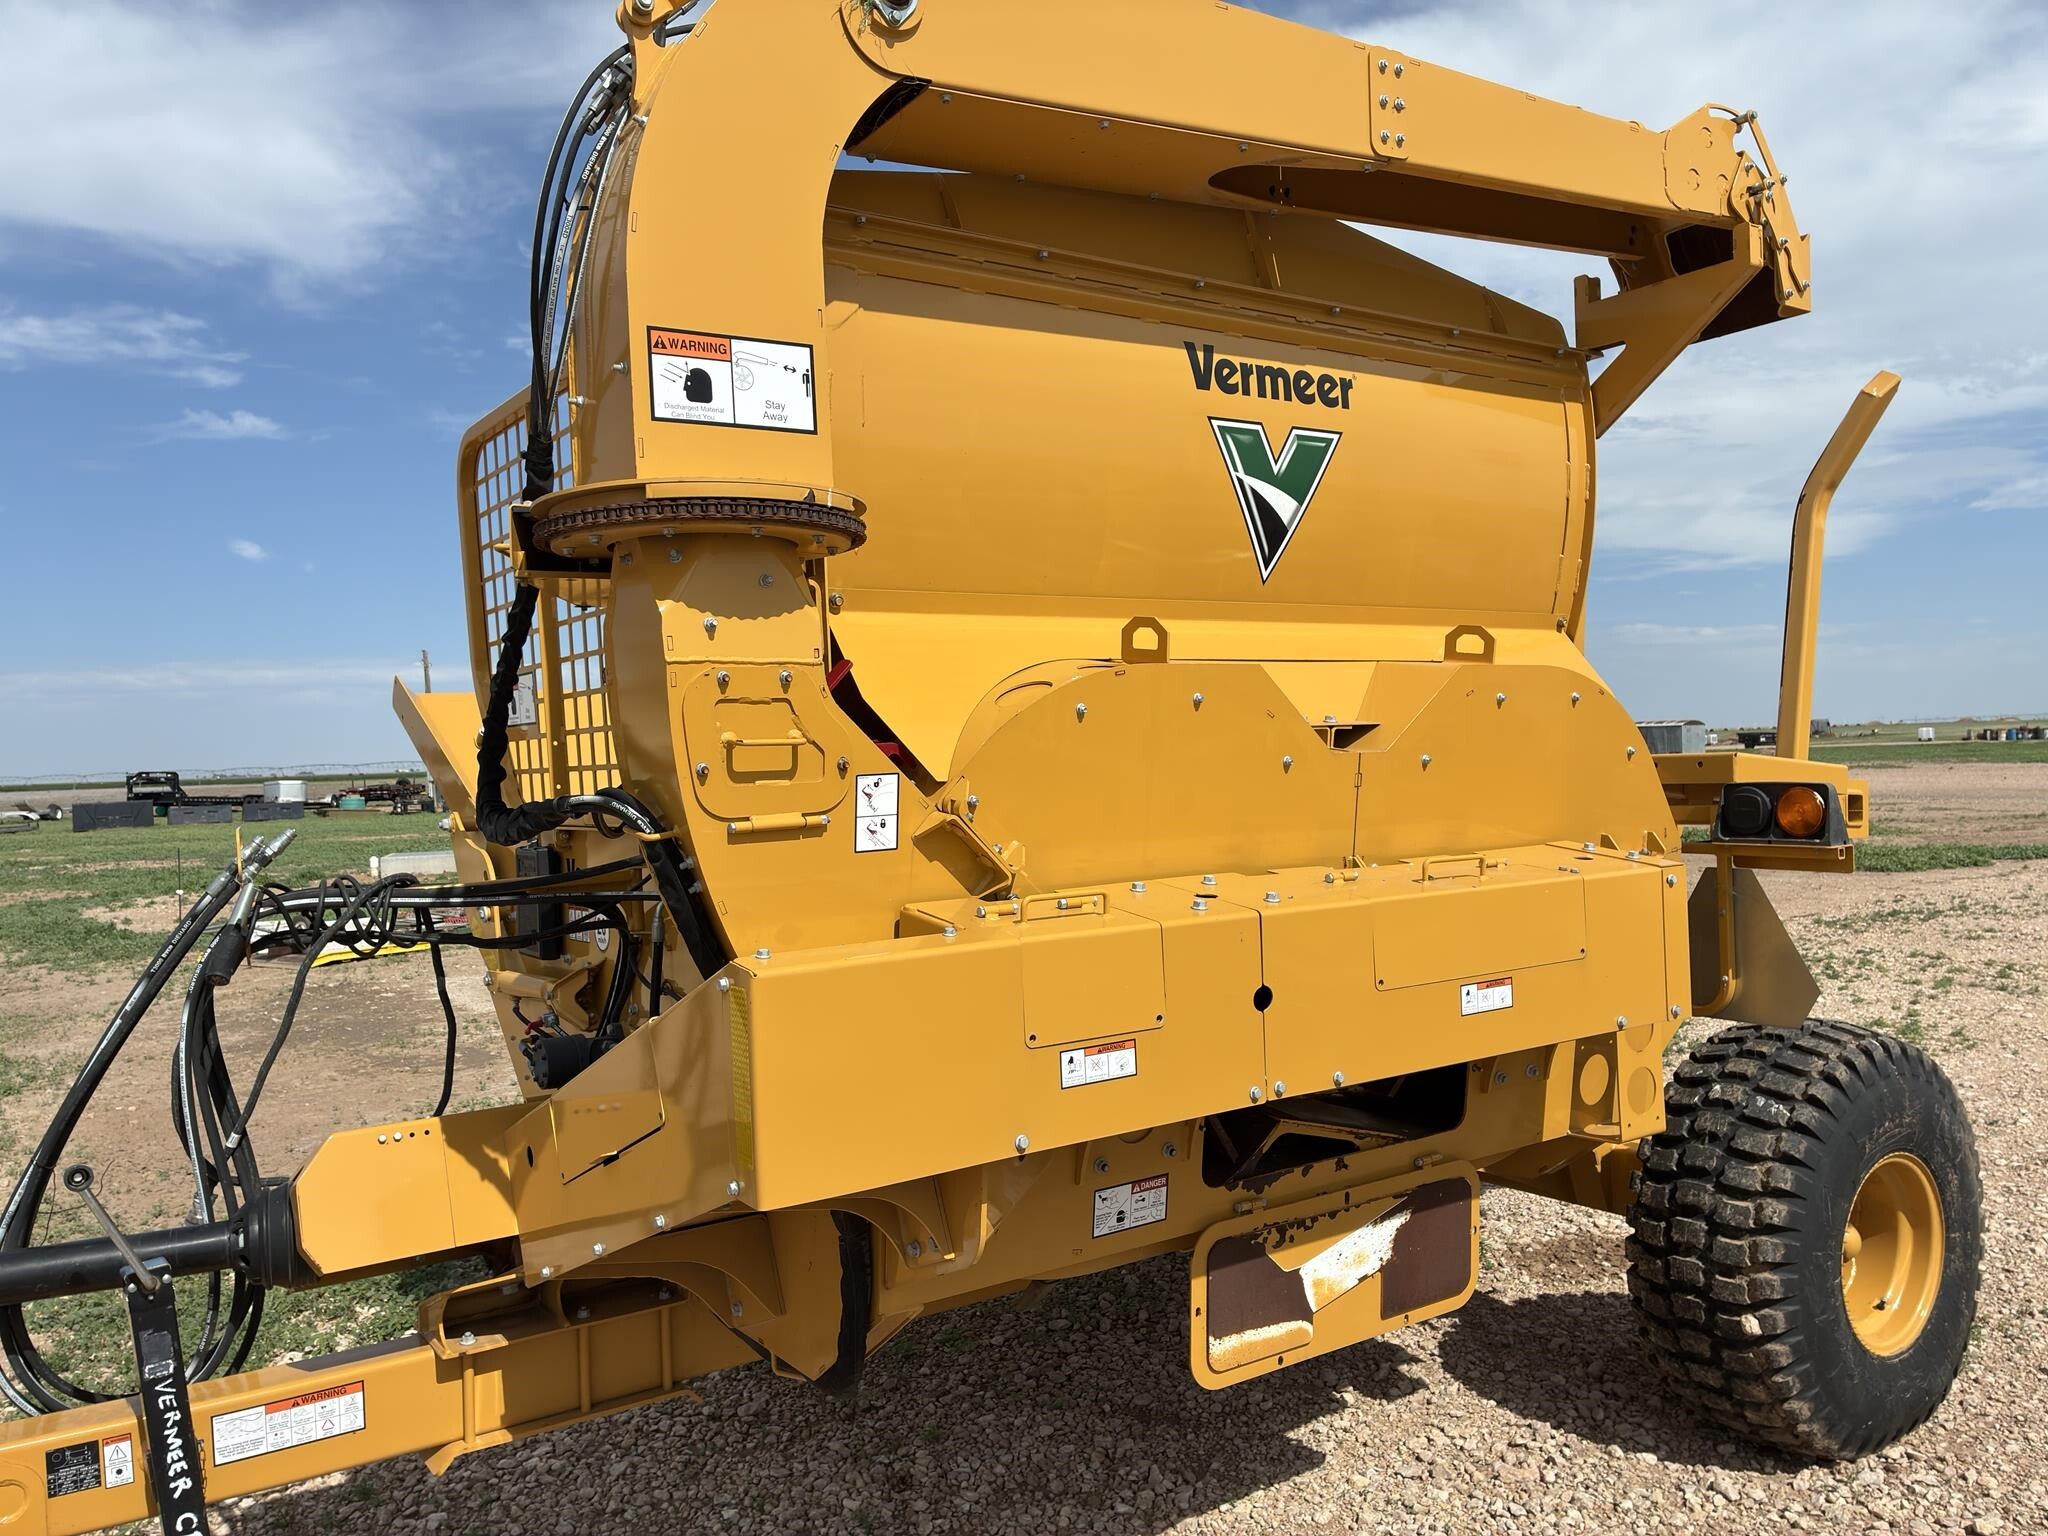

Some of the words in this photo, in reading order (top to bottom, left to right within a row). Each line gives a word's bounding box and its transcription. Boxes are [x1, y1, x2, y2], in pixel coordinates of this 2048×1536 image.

[581, 150, 599, 180] DIEHARD
[668, 337, 728, 355] WARNING
[1183, 341, 1354, 410] Vermeer
[663, 402, 699, 412] Discharged
[700, 405, 725, 413] Material
[765, 399, 786, 412] Stay
[762, 410, 788, 423] Away
[171, 920, 192, 945] DIEHARD
[1101, 1042, 1126, 1053] WARNING
[1140, 1177, 1167, 1191] DANGER
[300, 1386, 347, 1405] WARNING
[154, 1377, 193, 1500] VERMEER
